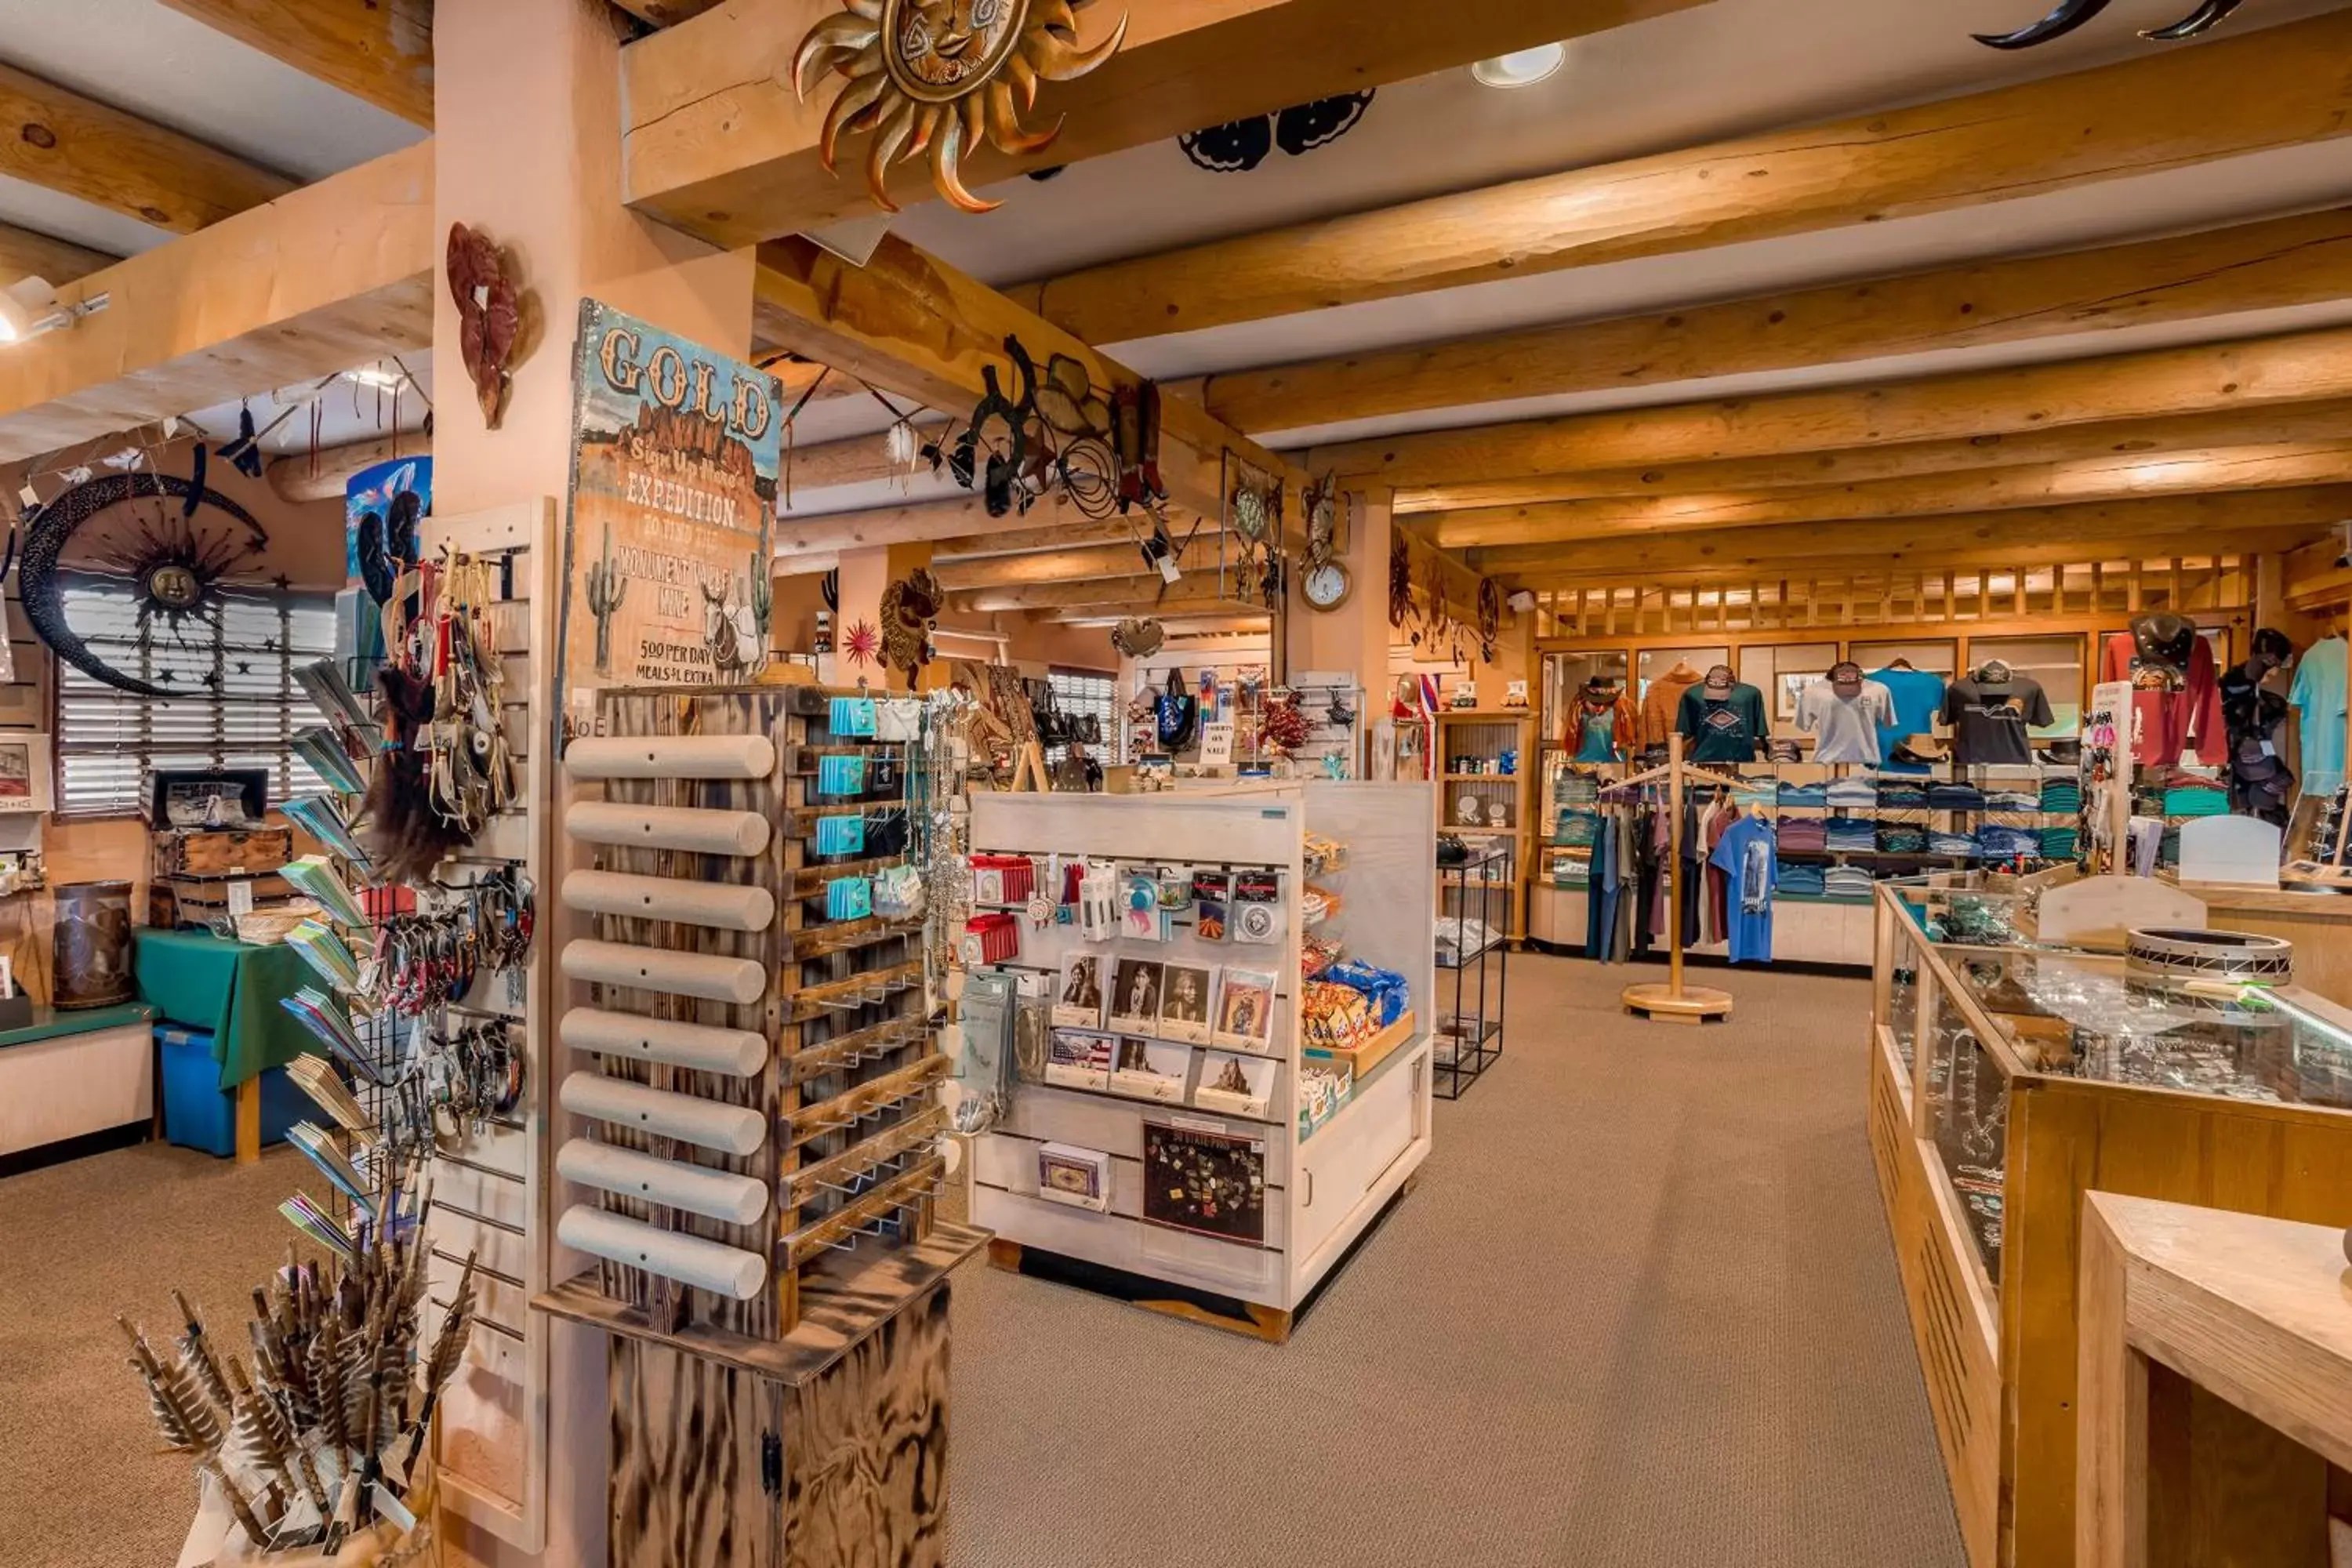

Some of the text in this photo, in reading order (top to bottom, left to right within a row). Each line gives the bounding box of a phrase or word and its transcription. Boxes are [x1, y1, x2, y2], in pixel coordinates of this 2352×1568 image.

[599, 327, 771, 441] GOLD
[626, 471, 736, 528] EXPEDITION
[618, 545, 689, 586] MONUMENT
[659, 586, 689, 619] MINE
[666, 644, 688, 662] PER
[689, 646, 712, 665] DAY
[636, 665, 669, 681] MEALS
[684, 669, 714, 685] EXTRA
